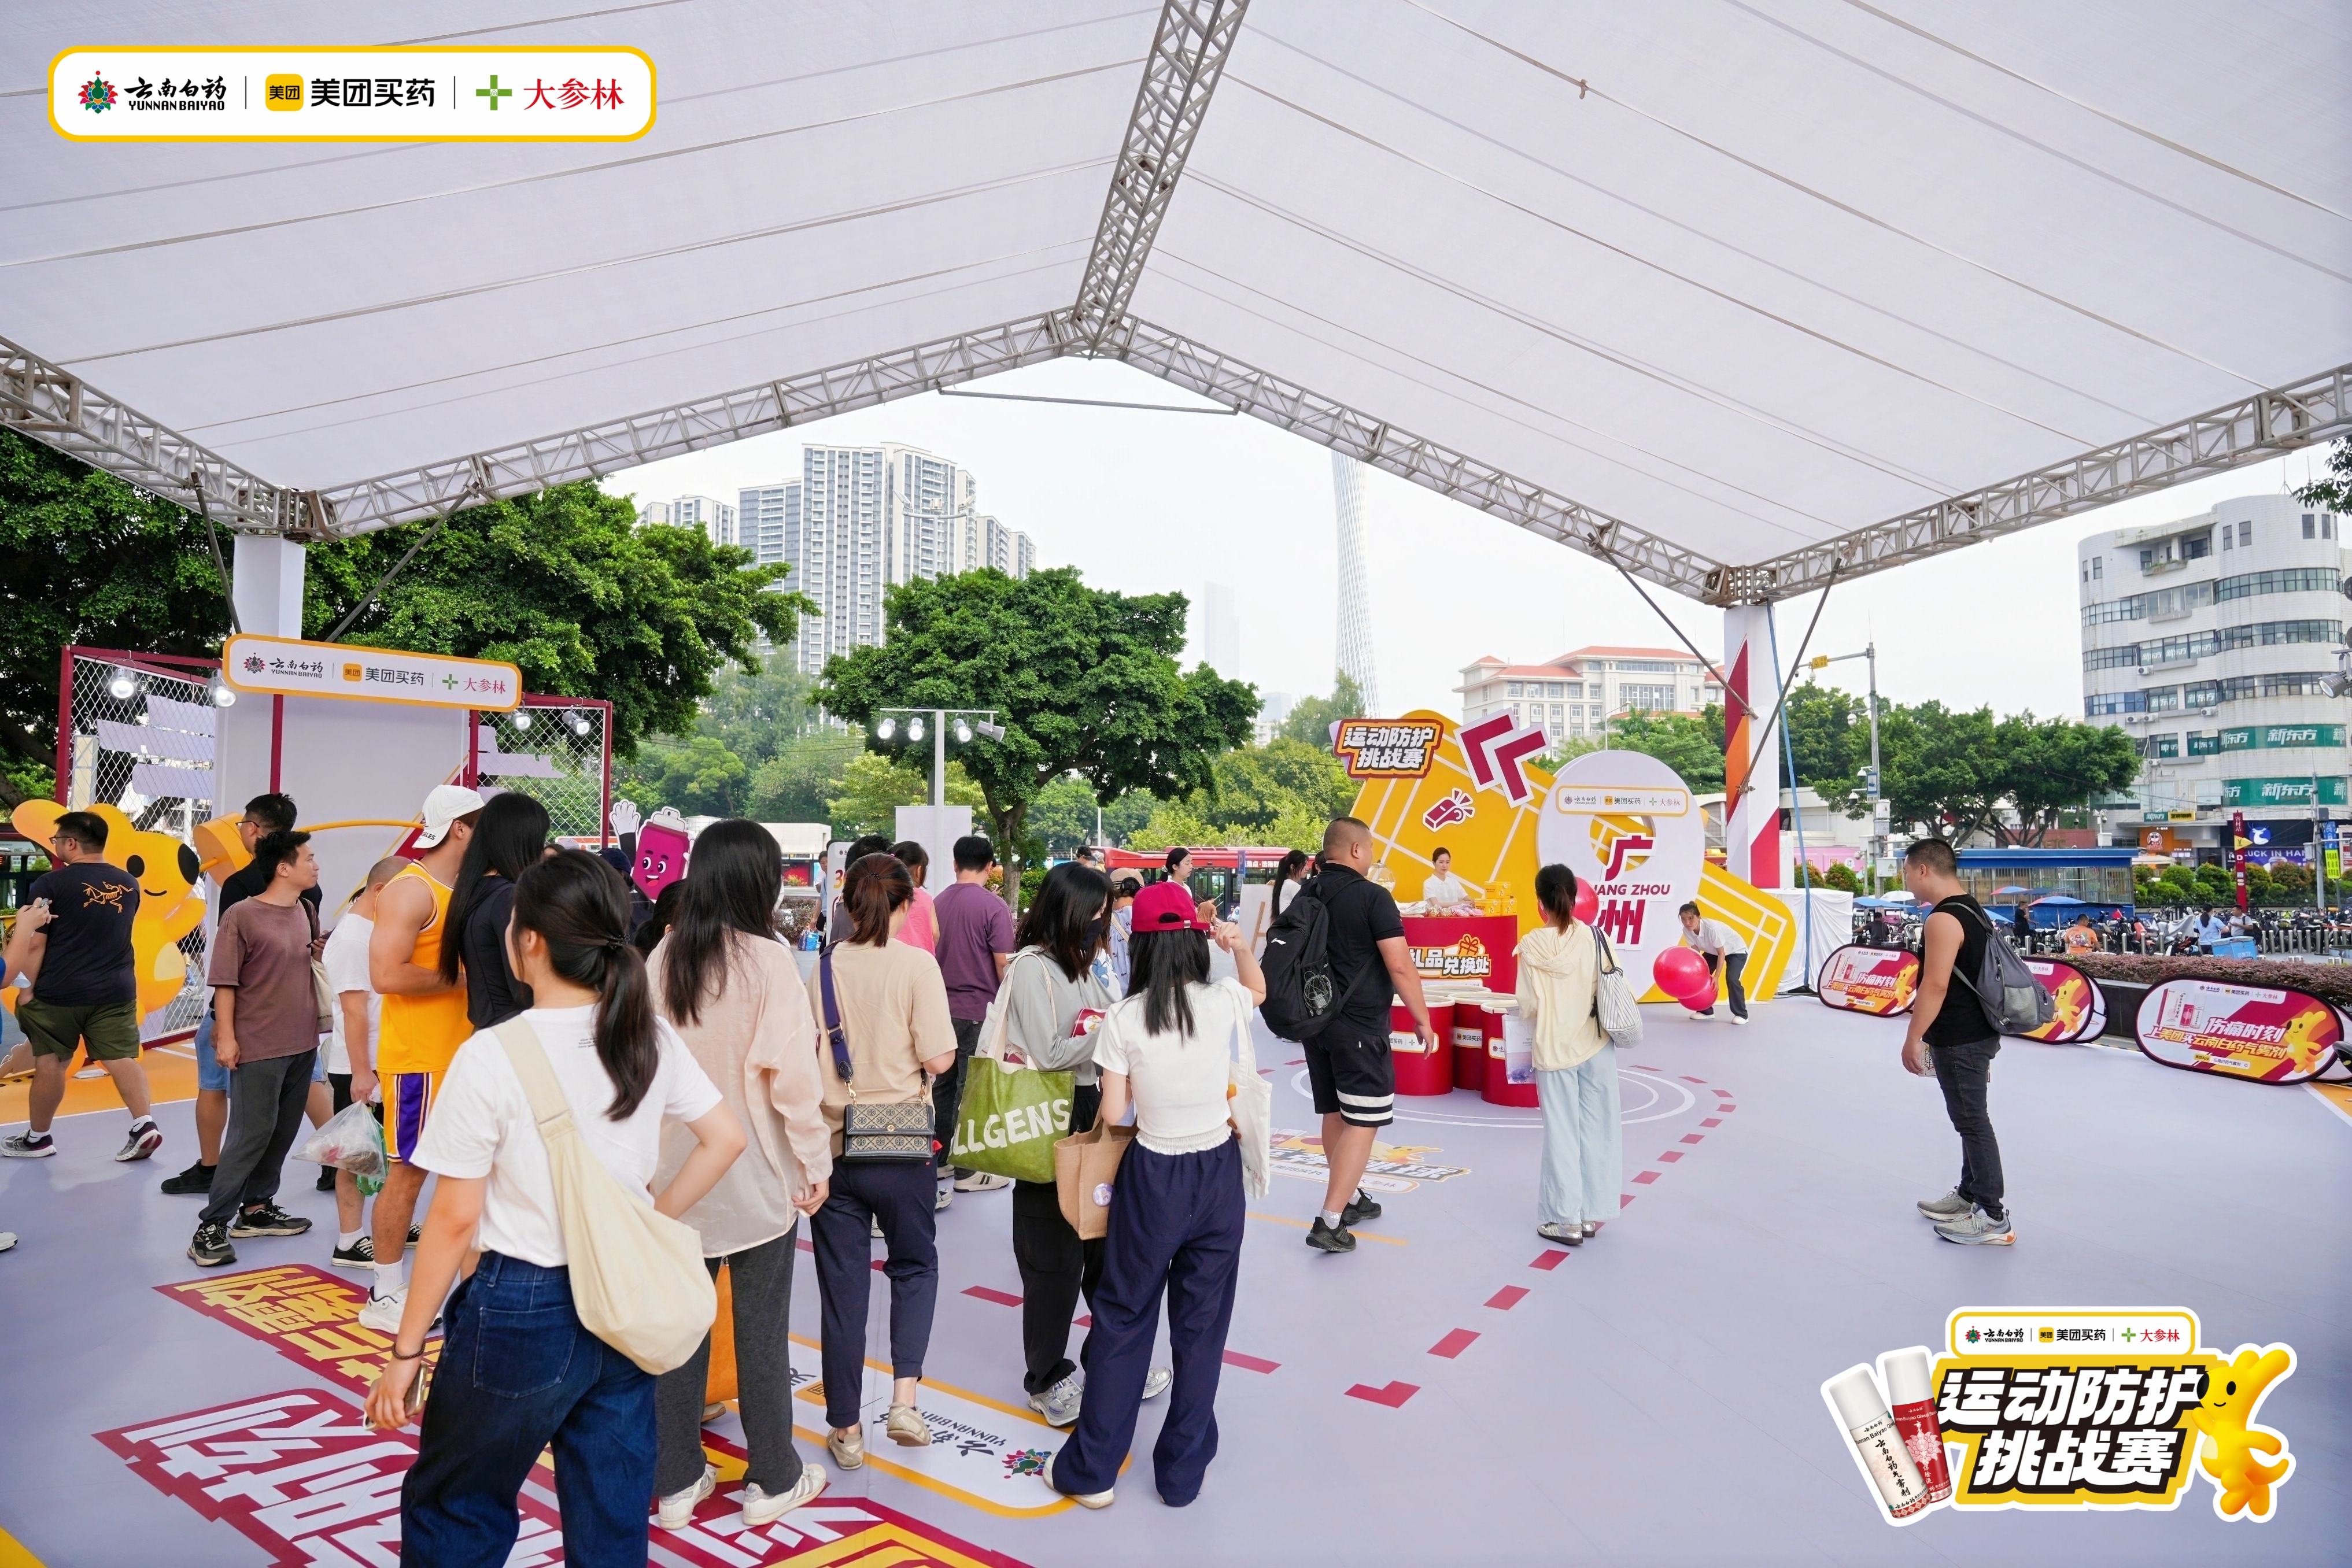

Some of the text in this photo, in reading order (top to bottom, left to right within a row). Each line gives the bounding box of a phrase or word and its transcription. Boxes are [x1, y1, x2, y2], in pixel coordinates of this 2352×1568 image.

[269, 658, 323, 672] 云南白药
[365, 668, 424, 686] 美团买药
[463, 677, 506, 694] 大参林
[1343, 727, 1434, 747] 运动防护
[2268, 728, 2317, 745] 新东方
[1357, 748, 1424, 768] 挑战赛
[1605, 835, 1653, 882] 广
[1631, 885, 1670, 895] ZHOU
[1824, 981, 1895, 999] 上美团买云南白药气雾剂
[1855, 972, 1897, 988] 伤痛时刻
[2205, 1018, 2285, 1042] 伤痛时刻
[2148, 1027, 2286, 1059] 上美团买云南白药气雾剂
[949, 1099, 1070, 1157] LLGENS
